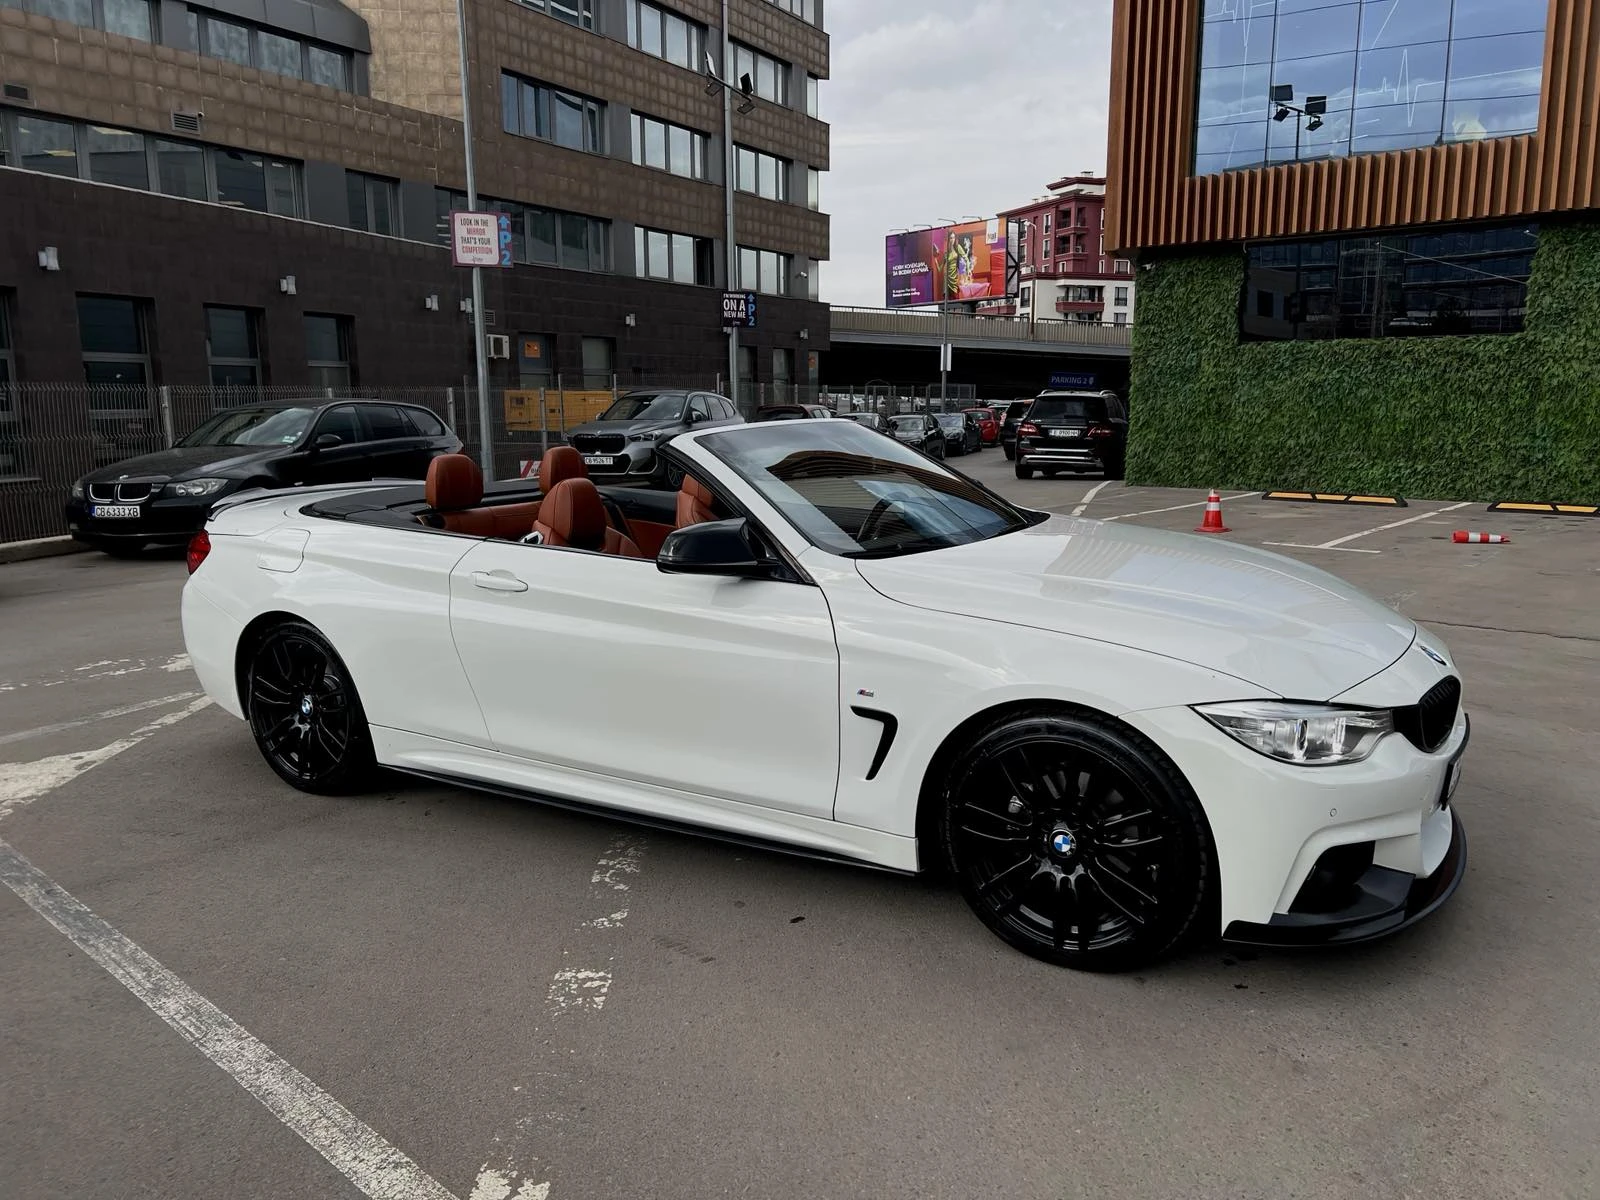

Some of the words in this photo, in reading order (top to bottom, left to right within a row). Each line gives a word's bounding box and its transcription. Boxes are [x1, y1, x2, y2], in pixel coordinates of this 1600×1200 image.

[460, 218, 472, 226] LOOK
[473, 218, 480, 226] IN
[480, 219, 488, 227] THE
[723, 299, 737, 310] ON
[739, 300, 746, 310] A
[1051, 376, 1082, 384] PARKING
